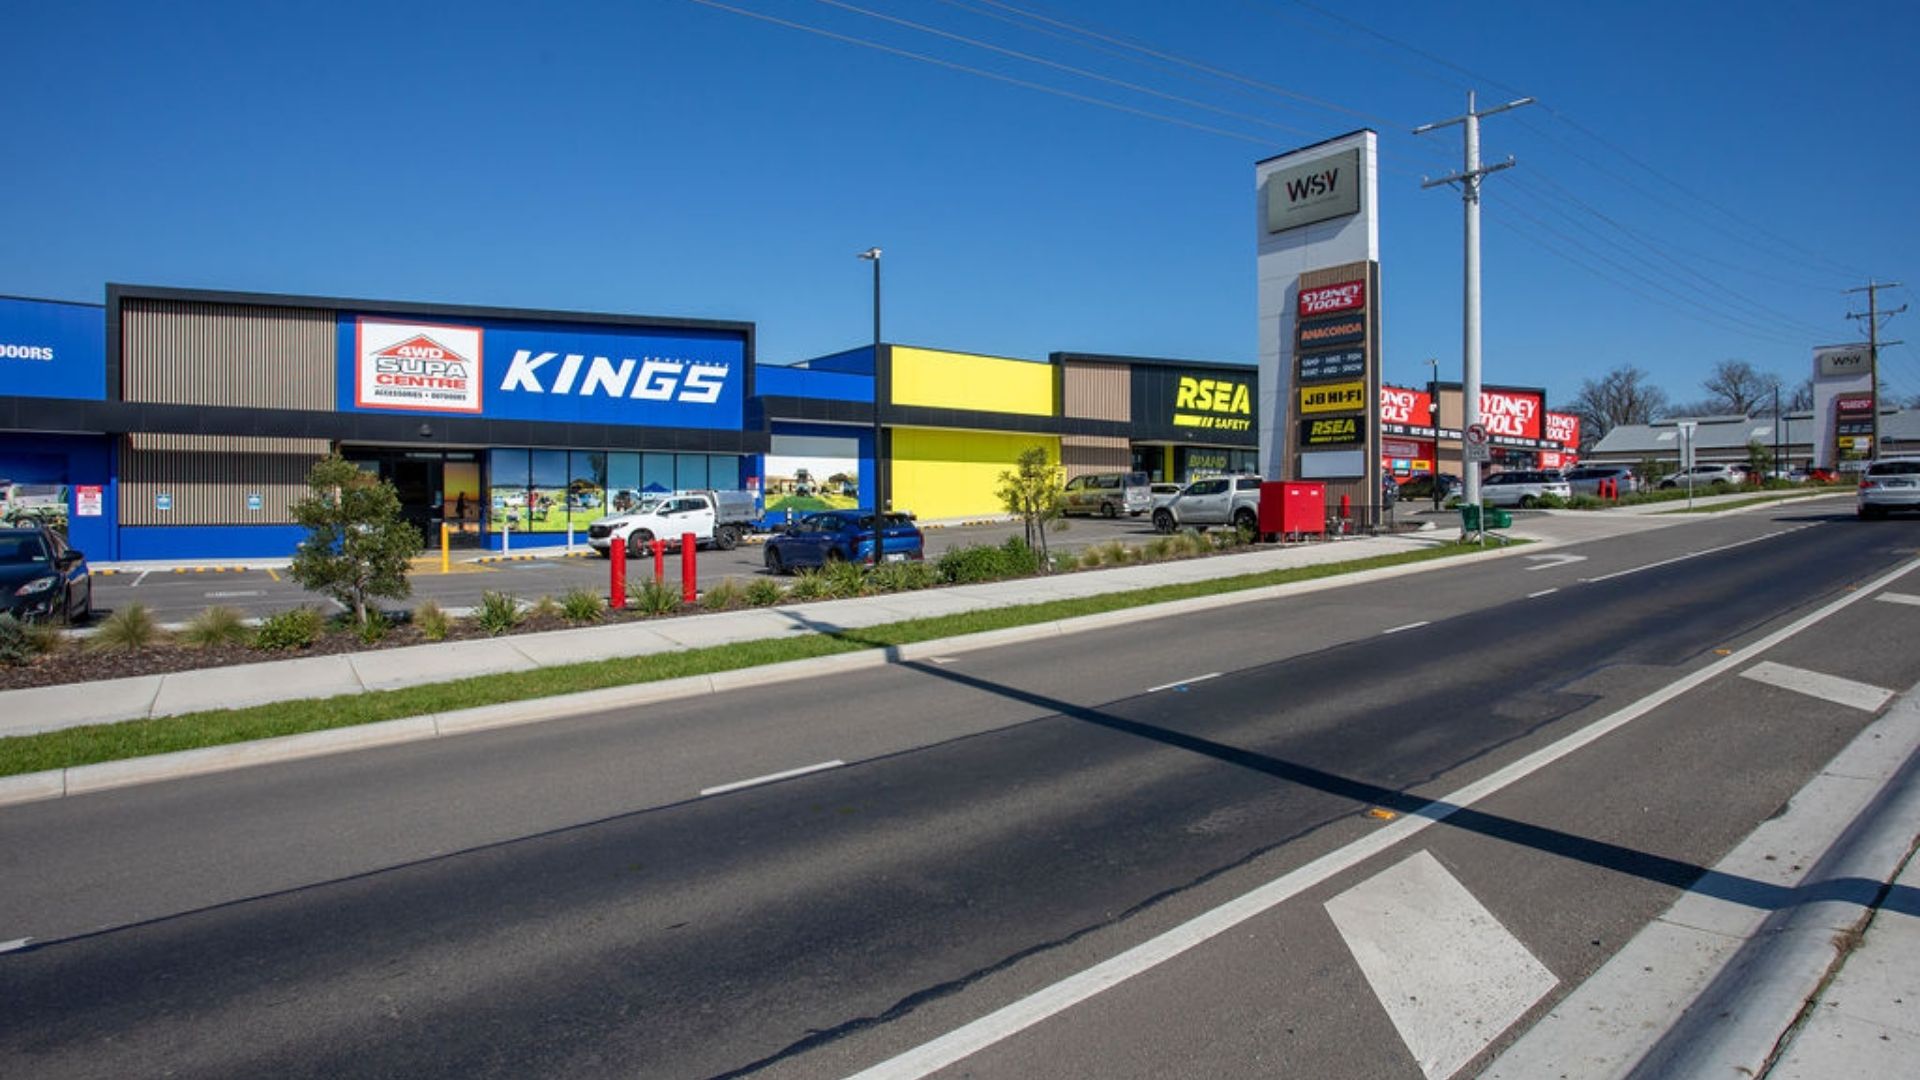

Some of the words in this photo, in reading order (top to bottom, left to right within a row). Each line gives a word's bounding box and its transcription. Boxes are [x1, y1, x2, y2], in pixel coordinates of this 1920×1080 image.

[1287, 168, 1339, 202] WSY
[1303, 284, 1360, 302] SYDNEY
[1308, 295, 1352, 312] TOOLS
[1301, 323, 1362, 340] ANACONDA
[396, 346, 443, 358] 4WD
[376, 357, 468, 378] SUPA
[376, 374, 466, 389] CENTRE
[500, 350, 729, 403] KINGS
[374, 389, 422, 398] ACCESSORIES
[1176, 376, 1251, 414] RSEA
[1305, 392, 1325, 405] JB
[1328, 389, 1362, 403] HI-FI
[1381, 389, 1417, 409] DNEY
[1381, 405, 1412, 422] OLS
[1479, 393, 1538, 418] YDNEY
[1214, 418, 1251, 431] SAFETY
[1312, 419, 1356, 434] RSEA
